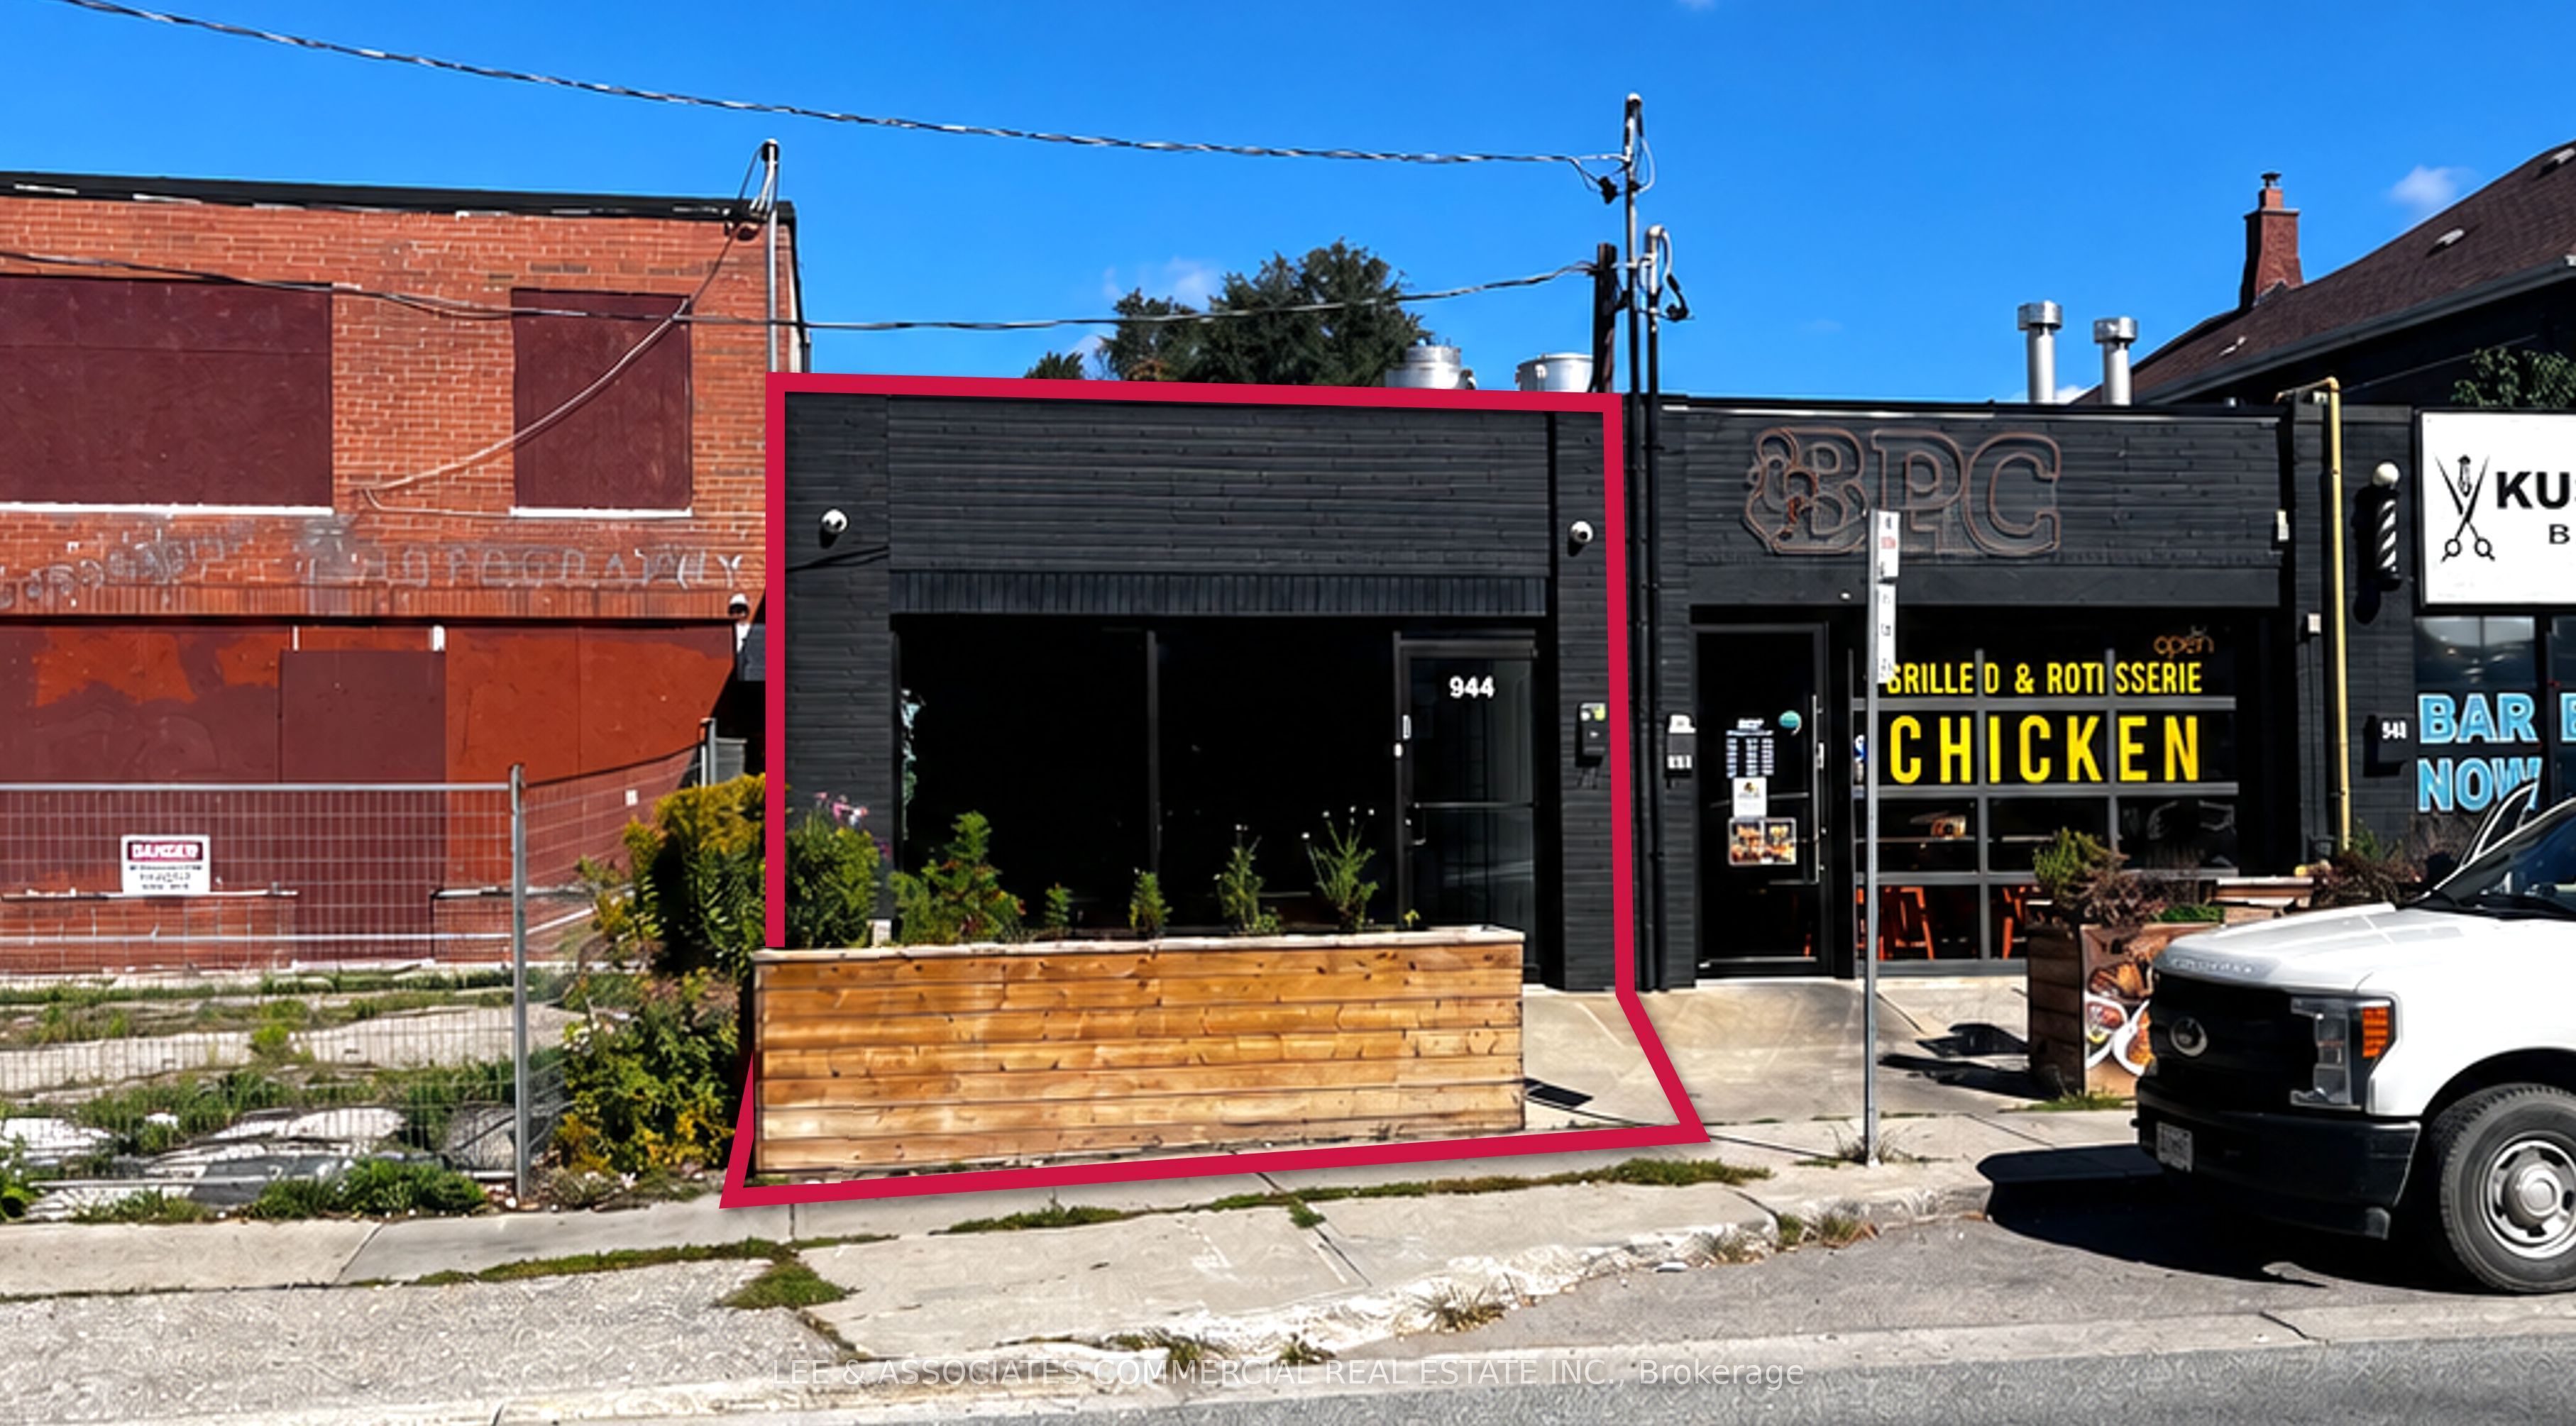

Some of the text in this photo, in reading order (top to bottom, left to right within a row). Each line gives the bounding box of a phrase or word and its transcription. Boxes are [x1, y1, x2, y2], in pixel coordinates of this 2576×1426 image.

[1758, 427, 2059, 554] BPC
[2497, 471, 2576, 509] KU
[1449, 675, 1495, 699] 944
[2014, 663, 2035, 694] &
[2047, 662, 2202, 694] ROTISSERIE
[2417, 692, 2539, 744] BAR
[1890, 715, 2199, 784] CHICKEN
[2417, 757, 2543, 812] NOW
